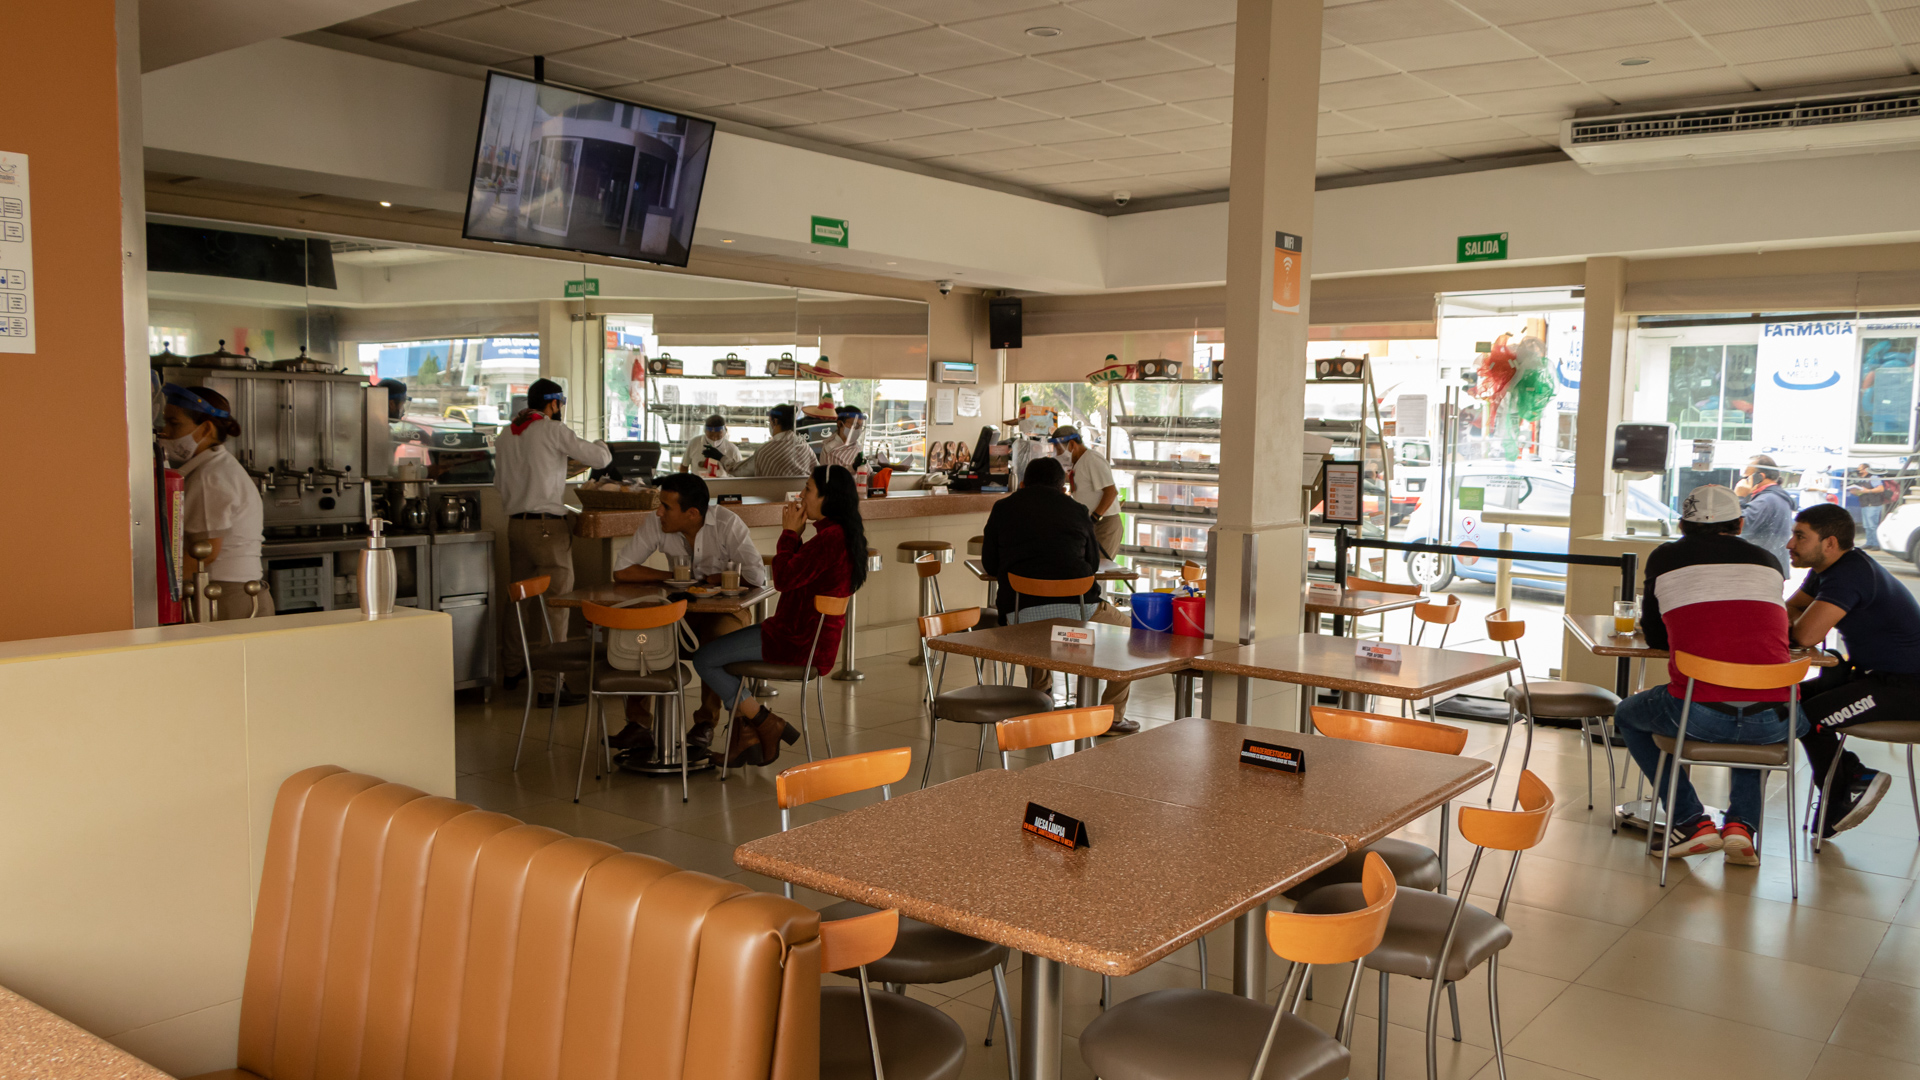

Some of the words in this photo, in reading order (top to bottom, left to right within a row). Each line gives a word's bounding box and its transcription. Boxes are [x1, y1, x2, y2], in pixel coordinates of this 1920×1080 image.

[1284, 236, 1294, 249] WIFI
[1465, 240, 1499, 256] SALIDA
[1764, 322, 1852, 336] FARMACIA
[1249, 746, 1292, 760] #MADEROESTUCASA
[1034, 816, 1048, 831] MESA
[1048, 821, 1065, 837] LIMPIA
